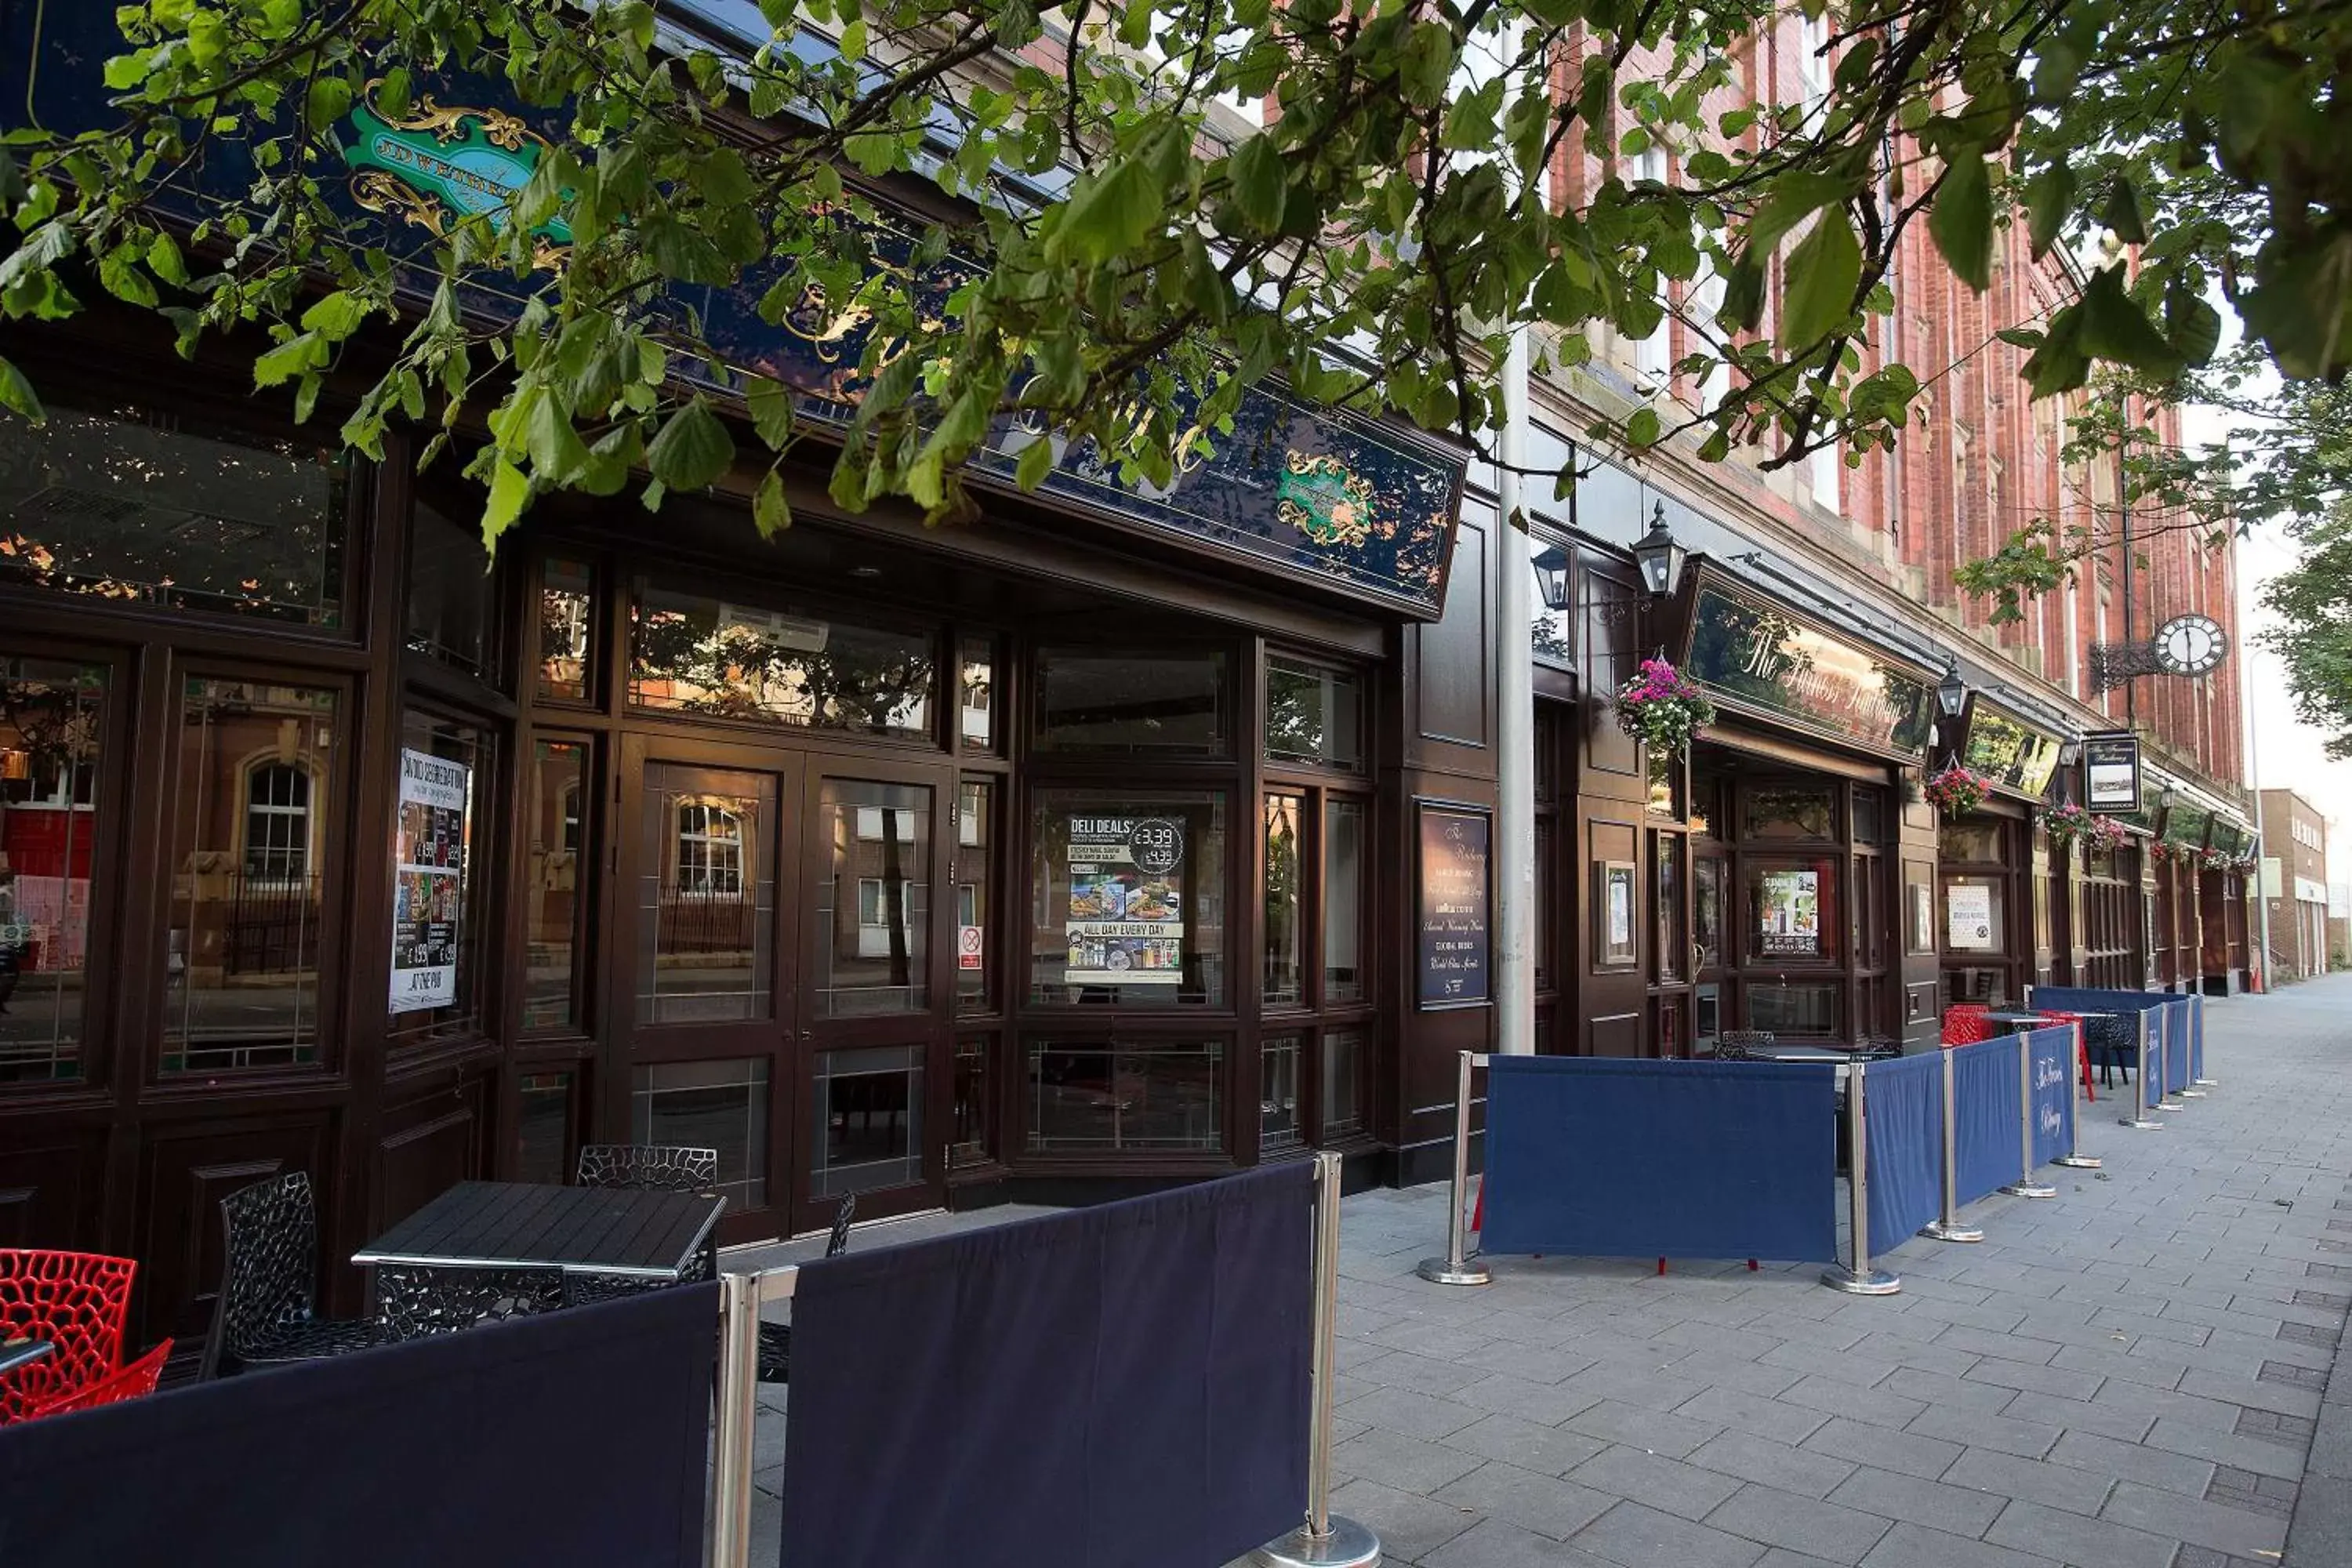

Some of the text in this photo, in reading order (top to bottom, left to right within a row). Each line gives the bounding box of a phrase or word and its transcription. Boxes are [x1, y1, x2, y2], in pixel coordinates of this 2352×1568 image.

[1740, 622, 1779, 681] The
[1071, 819, 1094, 833] DELI
[1084, 924, 1166, 935] ALL DAY EVERY DAY
